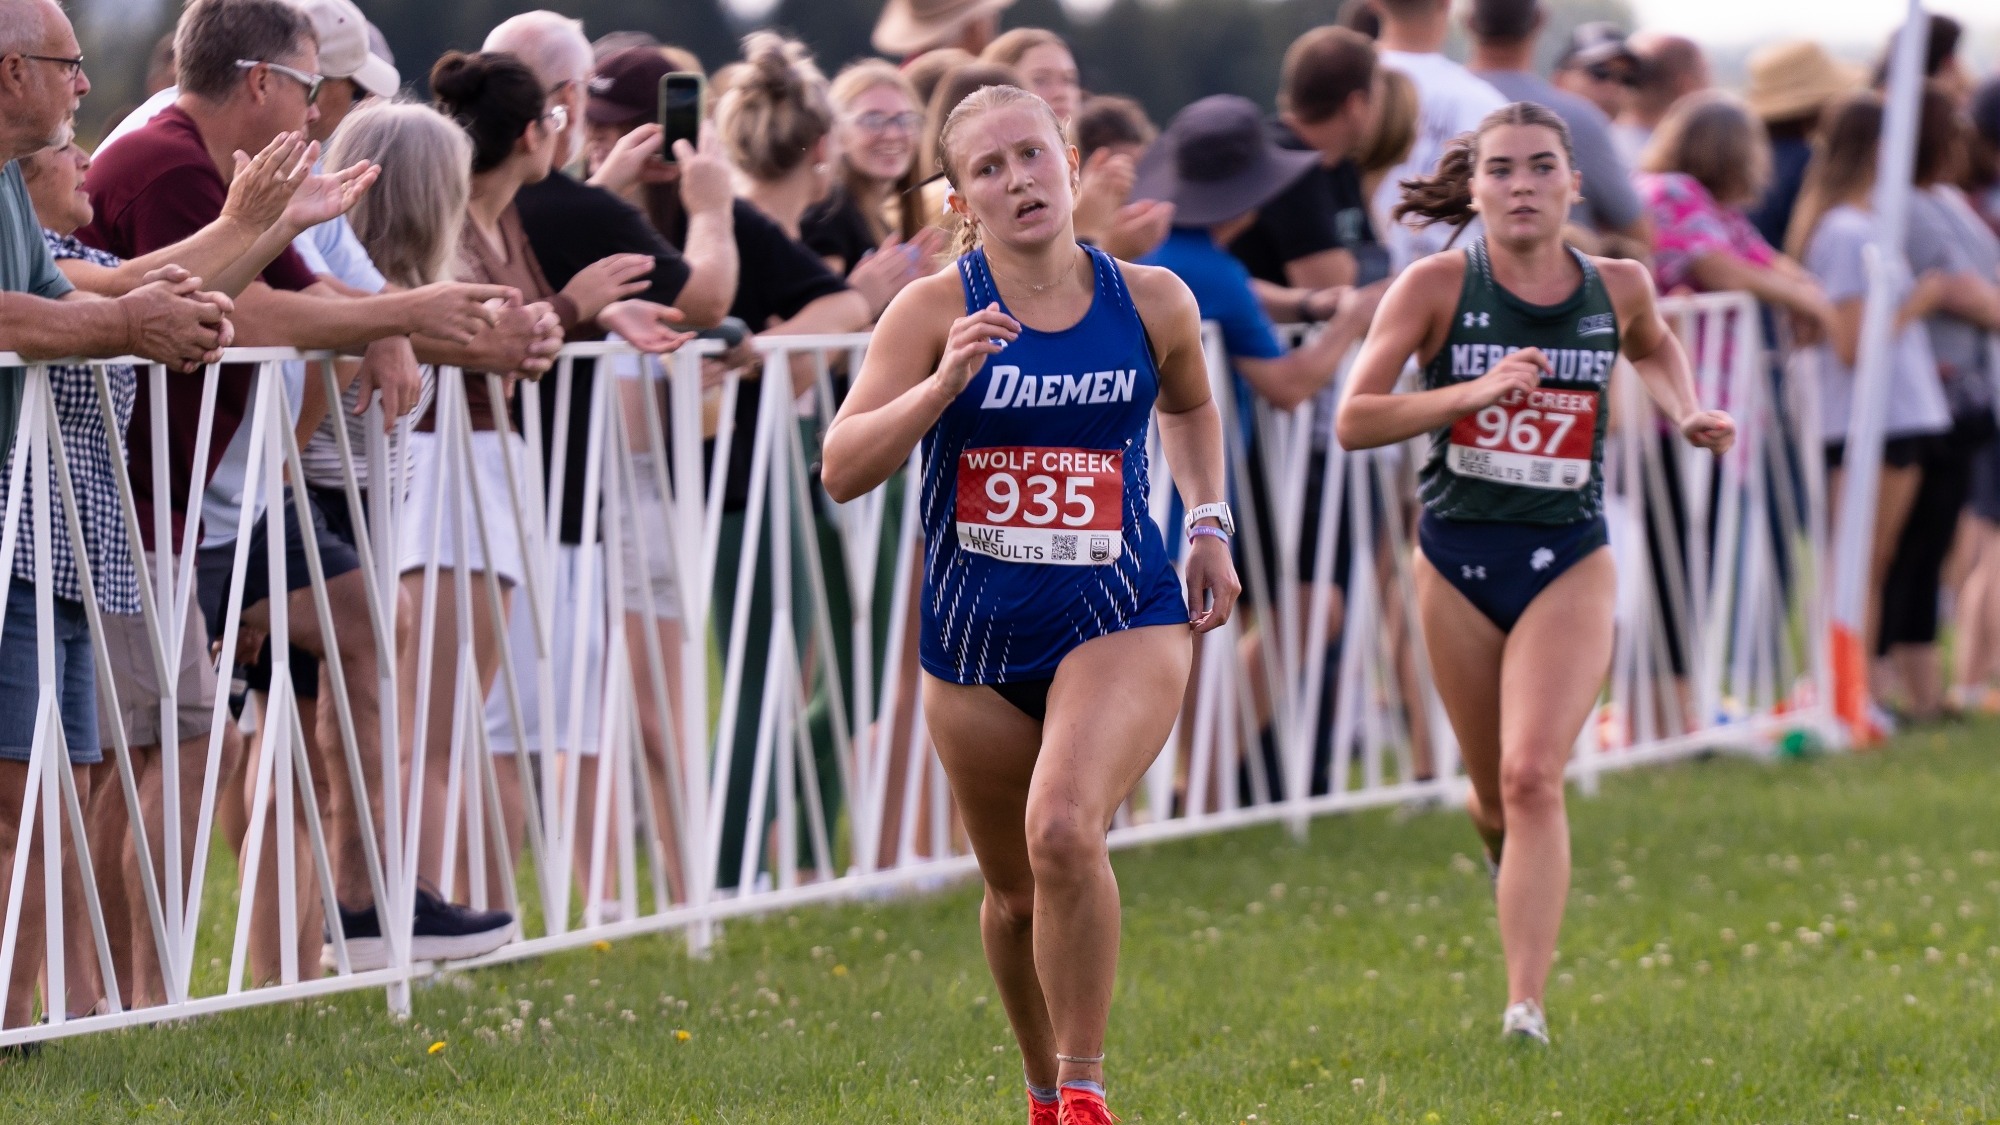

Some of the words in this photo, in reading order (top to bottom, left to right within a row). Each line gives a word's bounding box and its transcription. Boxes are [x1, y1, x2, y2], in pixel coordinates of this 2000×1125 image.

[980, 365, 1136, 409] DAEMEN
[1527, 391, 1593, 412] CREEK
[1475, 405, 1577, 455] 967
[966, 451, 1036, 470] WOLF
[1041, 452, 1115, 473] CREEK
[1460, 450, 1492, 464] LIVE
[1458, 459, 1523, 481] RESULTS
[985, 472, 1095, 527] 935
[968, 526, 1005, 543] LIVE
[971, 539, 1044, 560] RESULTS
